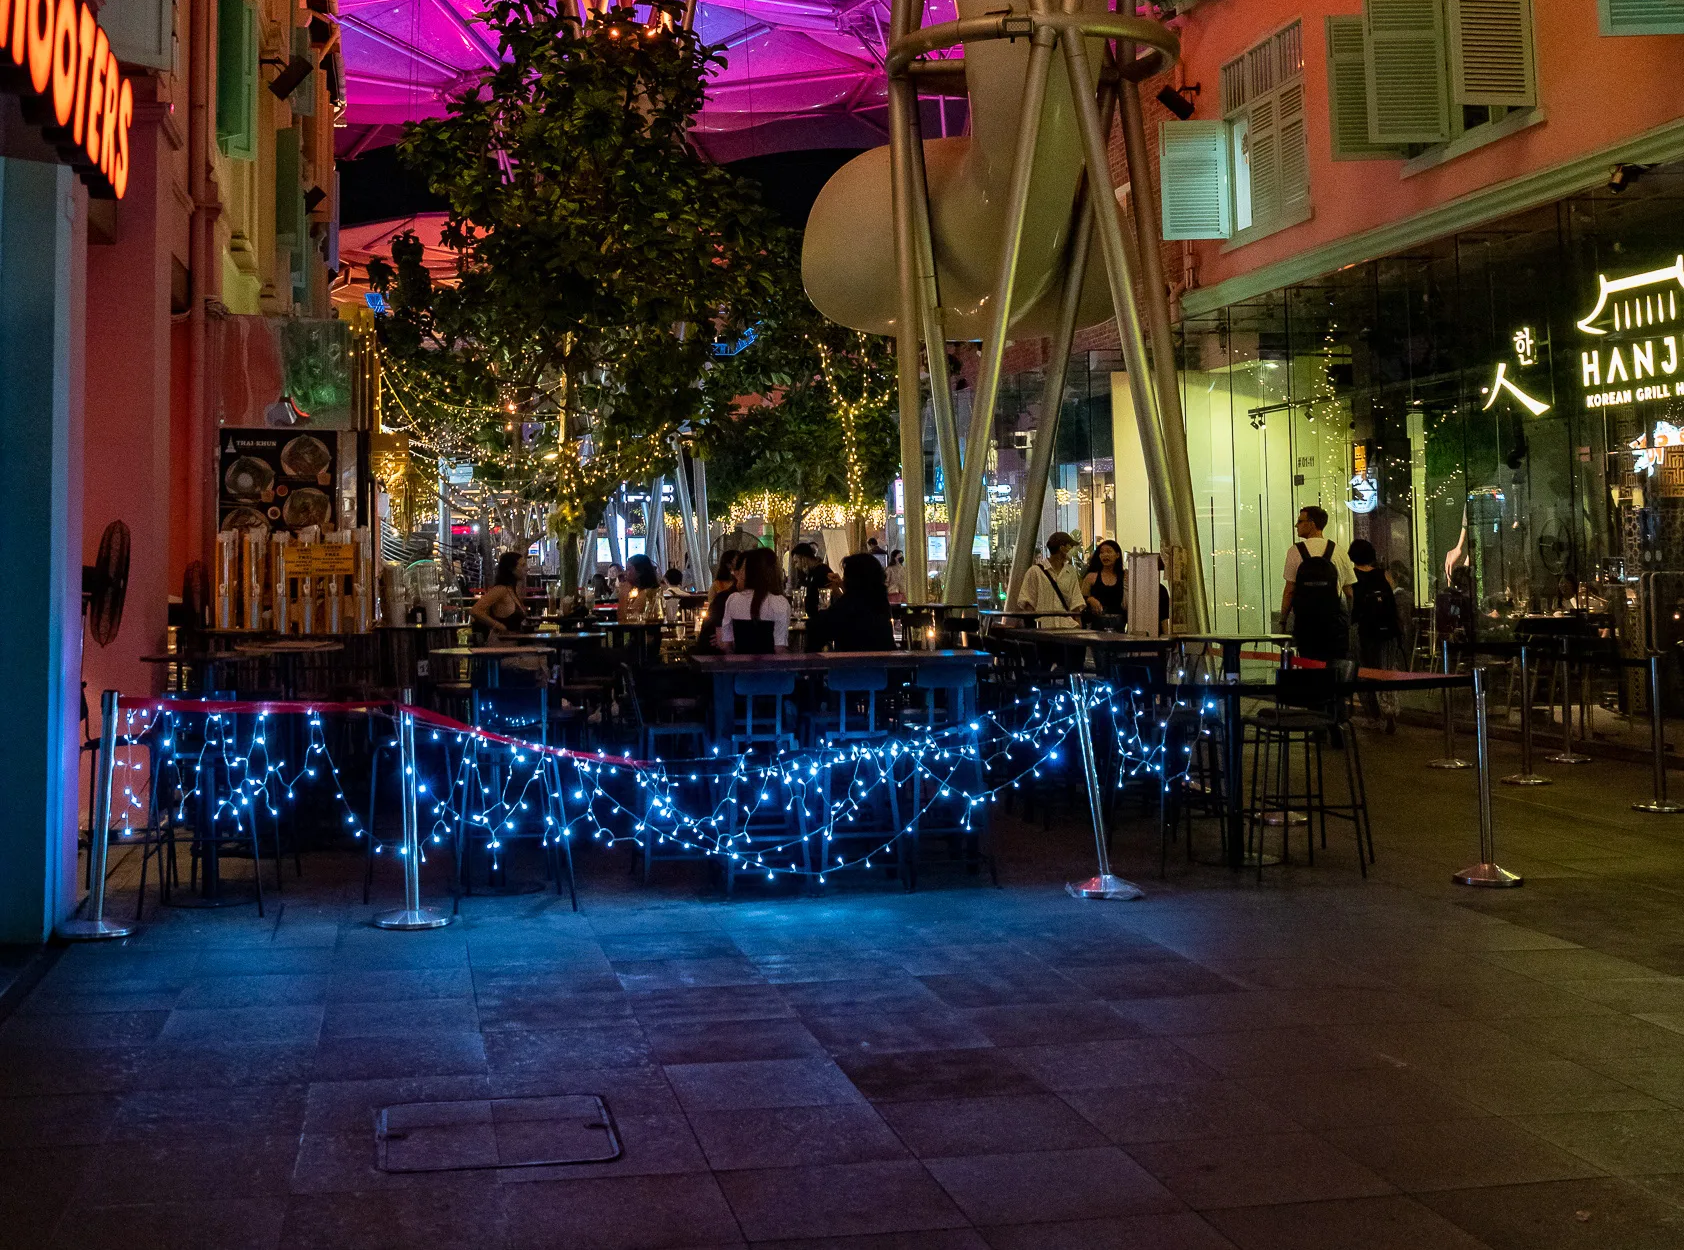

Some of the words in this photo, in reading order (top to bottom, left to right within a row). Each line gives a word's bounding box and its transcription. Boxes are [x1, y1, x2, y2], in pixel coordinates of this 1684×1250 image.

[1513, 327, 1534, 366] 한
[1586, 390, 1632, 408] KOREAN
[1636, 384, 1671, 402] GRILL
